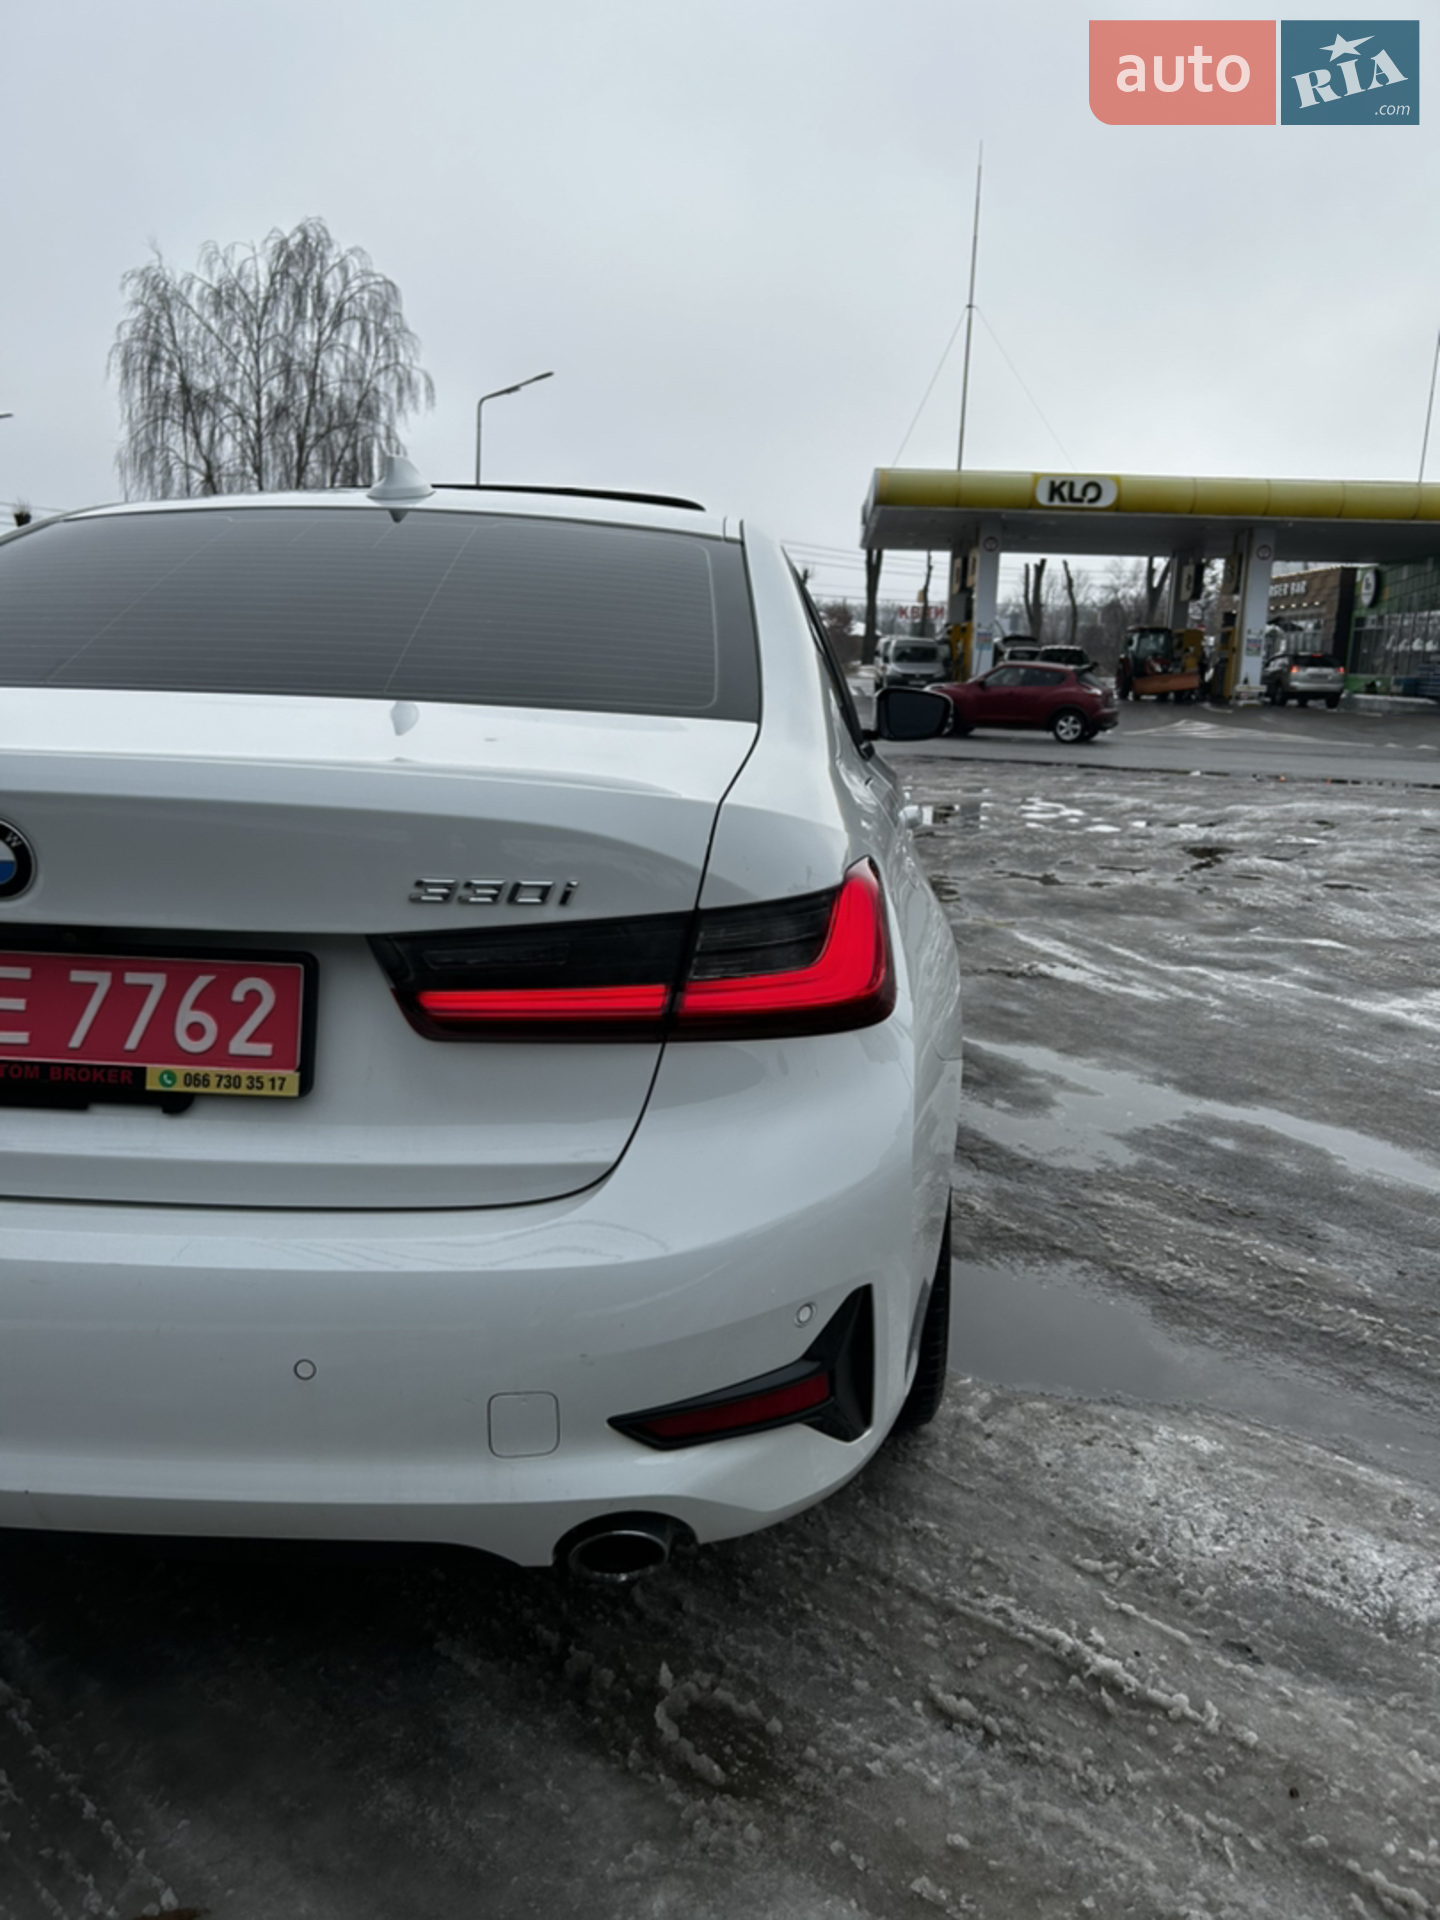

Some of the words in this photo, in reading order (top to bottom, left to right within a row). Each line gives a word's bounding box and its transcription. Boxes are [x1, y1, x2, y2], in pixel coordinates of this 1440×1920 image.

[1047, 479, 1103, 504] KLO
[409, 879, 579, 906] 330i
[67, 969, 277, 1057] 7762
[183, 1072, 211, 1088] 066
[215, 1074, 242, 1089] 730
[246, 1075, 264, 1090] 35
[268, 1077, 287, 1091] 17
